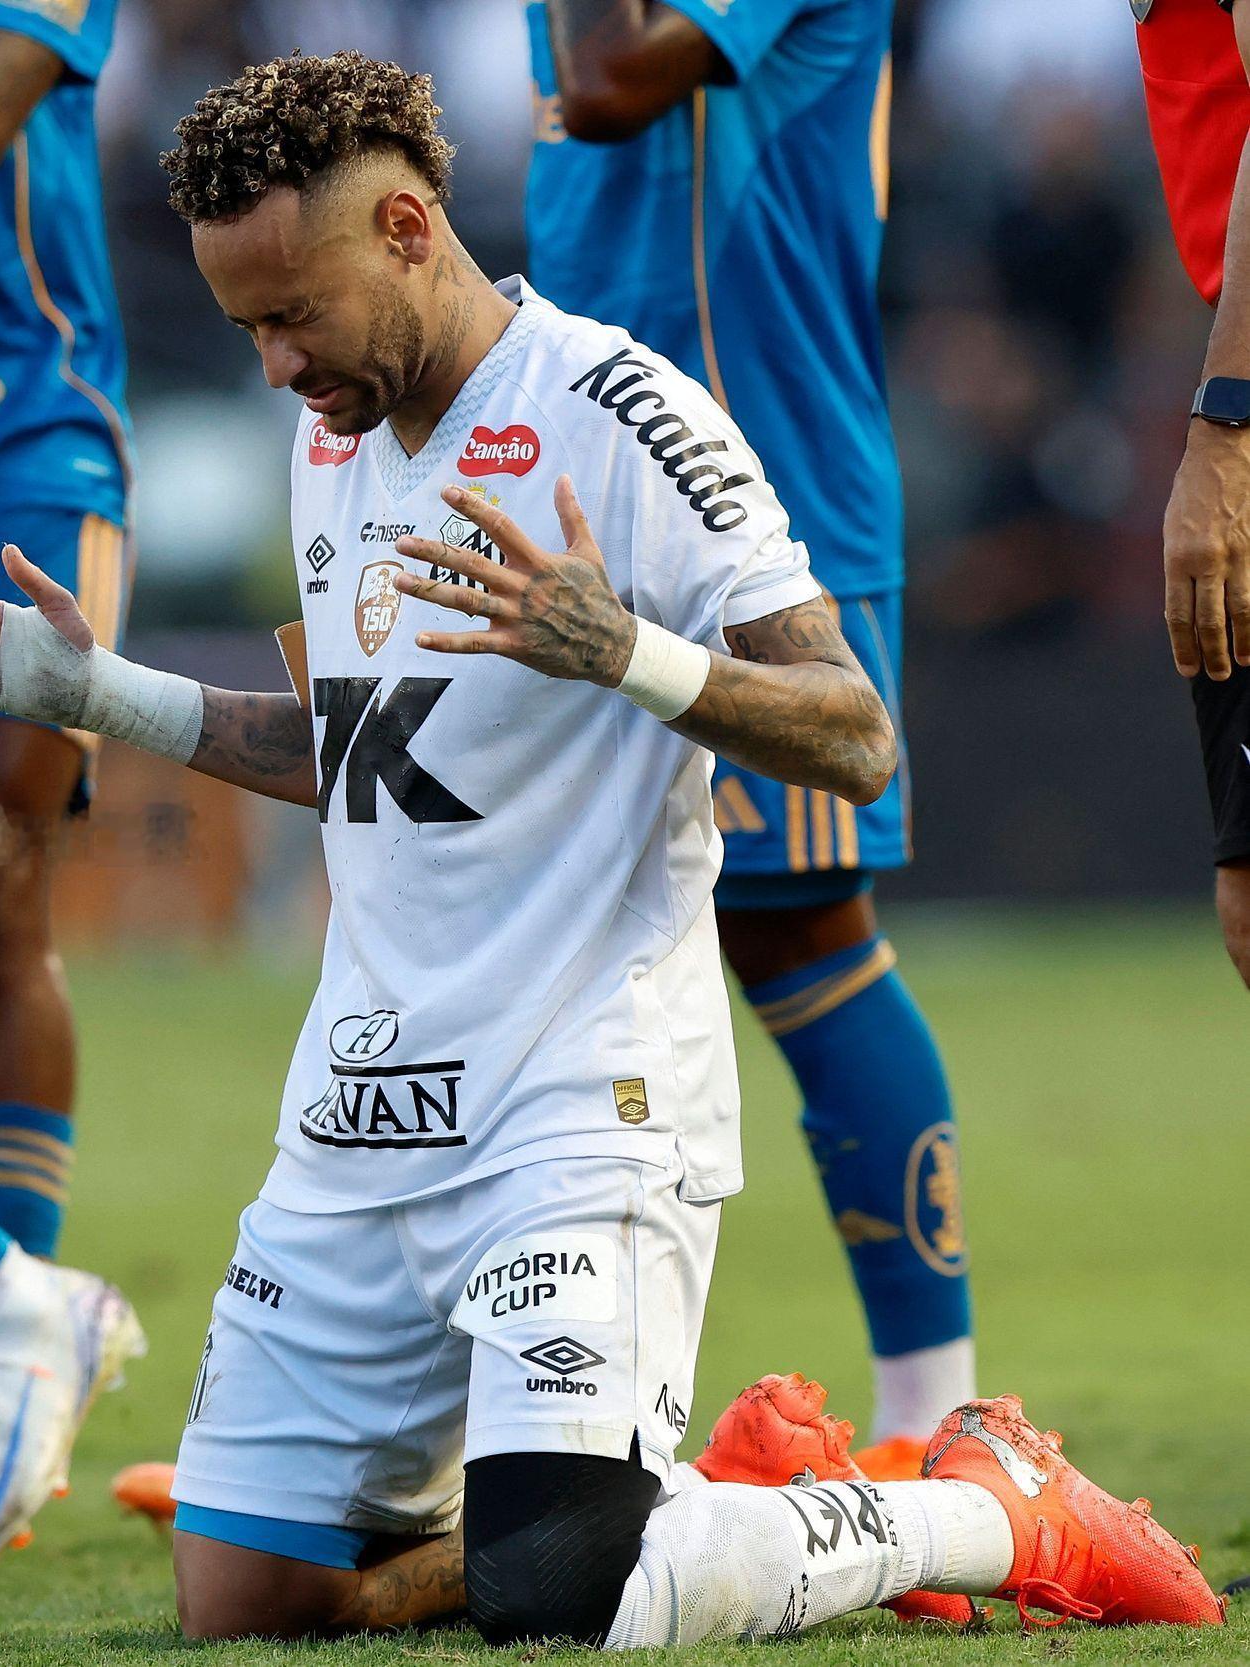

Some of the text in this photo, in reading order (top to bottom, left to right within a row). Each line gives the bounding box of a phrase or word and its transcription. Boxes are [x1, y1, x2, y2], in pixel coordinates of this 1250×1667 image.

[461, 437, 535, 466] Canção
[568, 348, 755, 532] Kicaldo
[306, 577, 329, 595] umbro
[362, 606, 393, 632] 150
[615, 1084, 643, 1092] OFFICIAL
[466, 1251, 597, 1302] VITÓRIA
[491, 1282, 557, 1318] CUP
[526, 1377, 598, 1397] umbro
